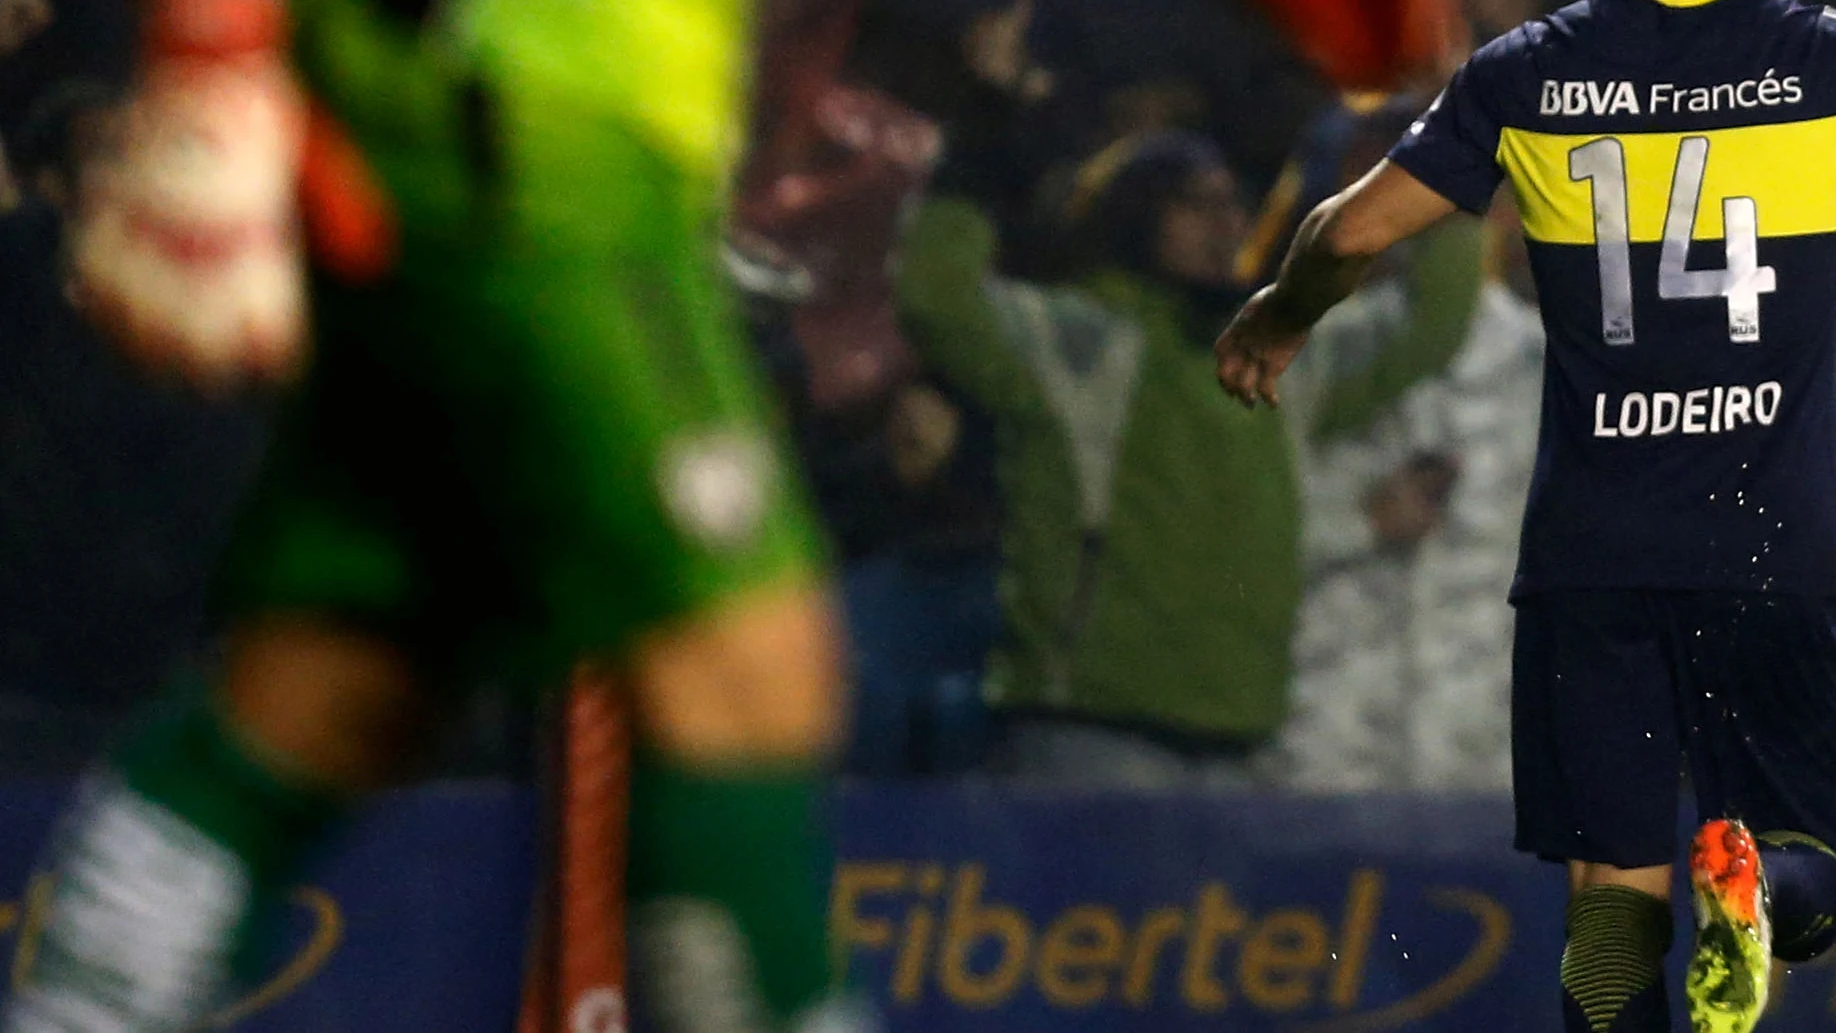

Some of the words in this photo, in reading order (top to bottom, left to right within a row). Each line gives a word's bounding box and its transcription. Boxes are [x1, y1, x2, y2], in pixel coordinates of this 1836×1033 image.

[1539, 79, 1641, 116] BBVA
[1650, 67, 1802, 114] Francés
[1567, 135, 1777, 346] 14
[1593, 380, 1782, 438] LODEIRO
[826, 860, 1386, 1011] Fibertel
